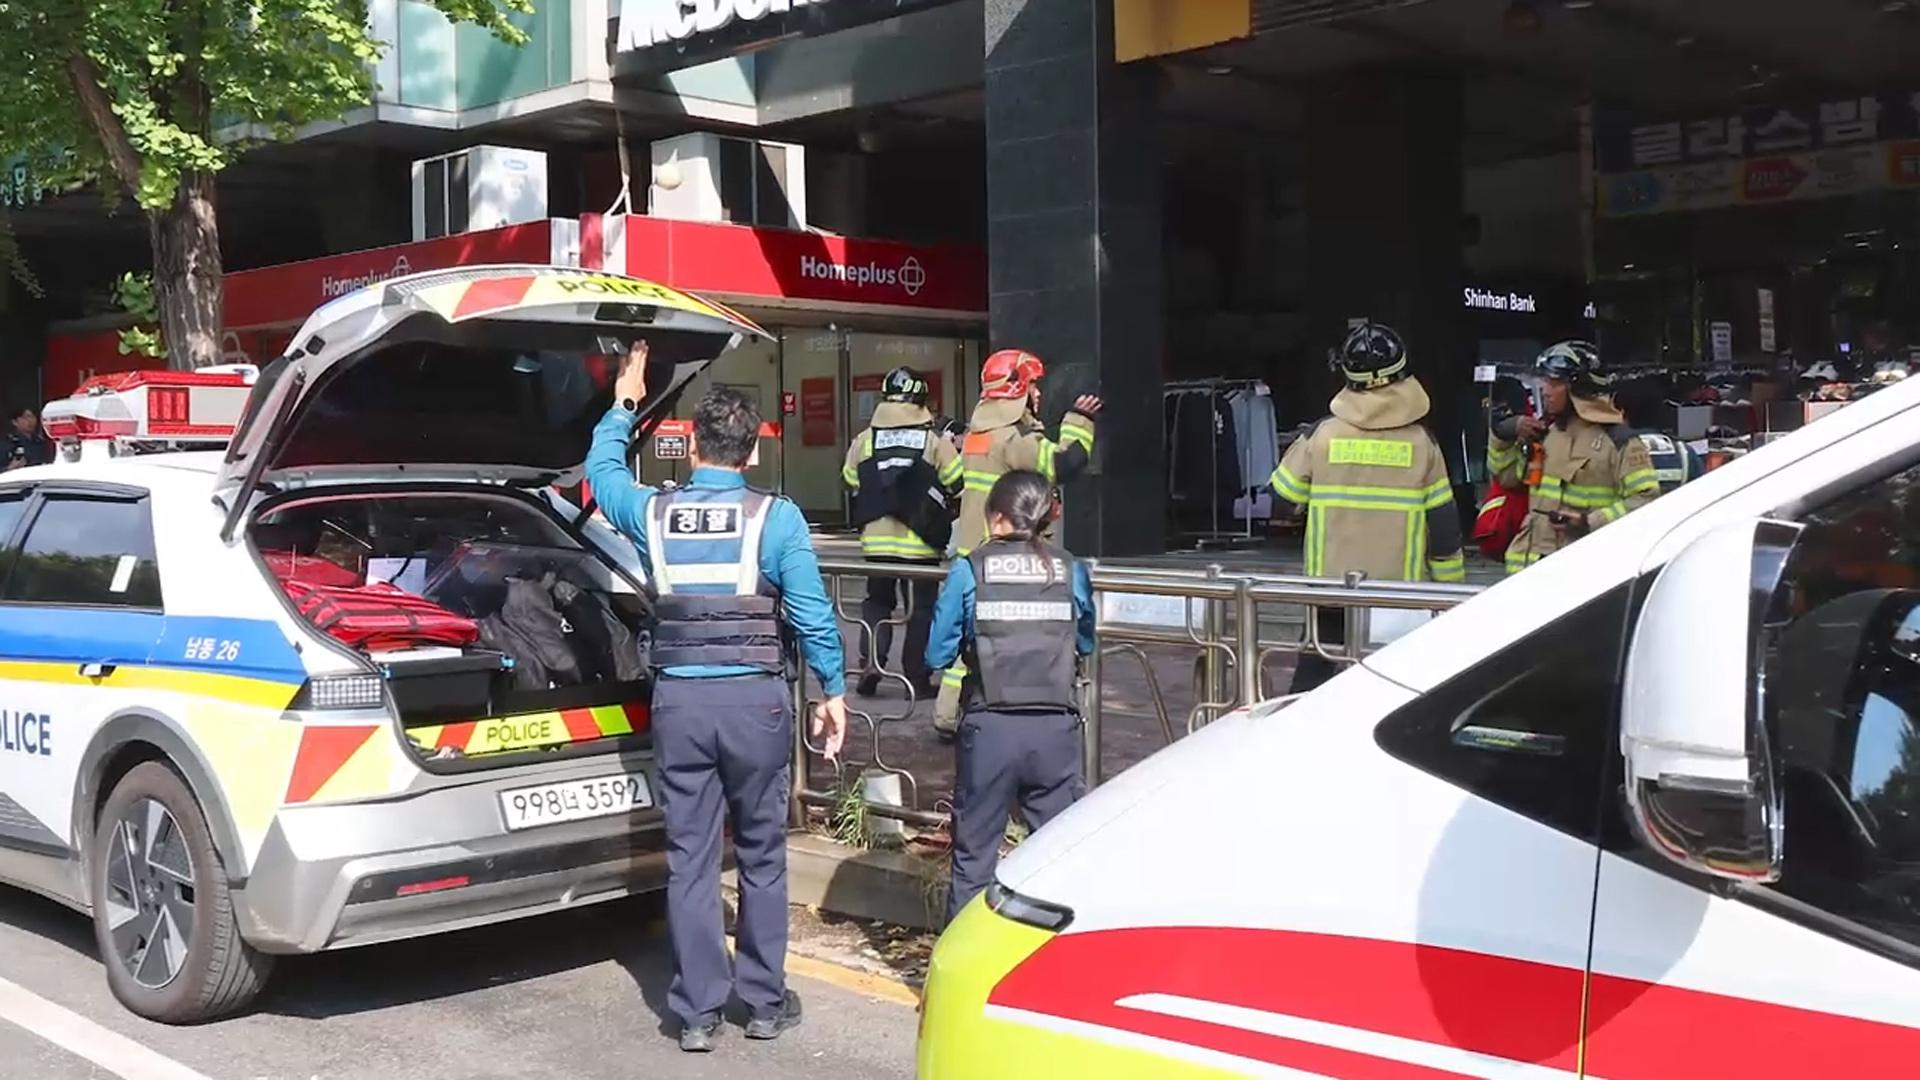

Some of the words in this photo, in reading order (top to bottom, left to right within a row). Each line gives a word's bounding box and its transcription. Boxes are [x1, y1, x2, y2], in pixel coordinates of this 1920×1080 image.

[801, 256, 896, 287] Homeplus
[557, 280, 676, 301] POLICE
[1464, 288, 1508, 310] Shinhan
[1510, 293, 1536, 312] Bank
[987, 557, 1064, 575] POLICE
[184, 636, 217, 660] 남동
[215, 639, 241, 662] 26
[0, 709, 51, 756] LICE
[486, 720, 552, 743] POLICE
[583, 777, 643, 811] 3592
